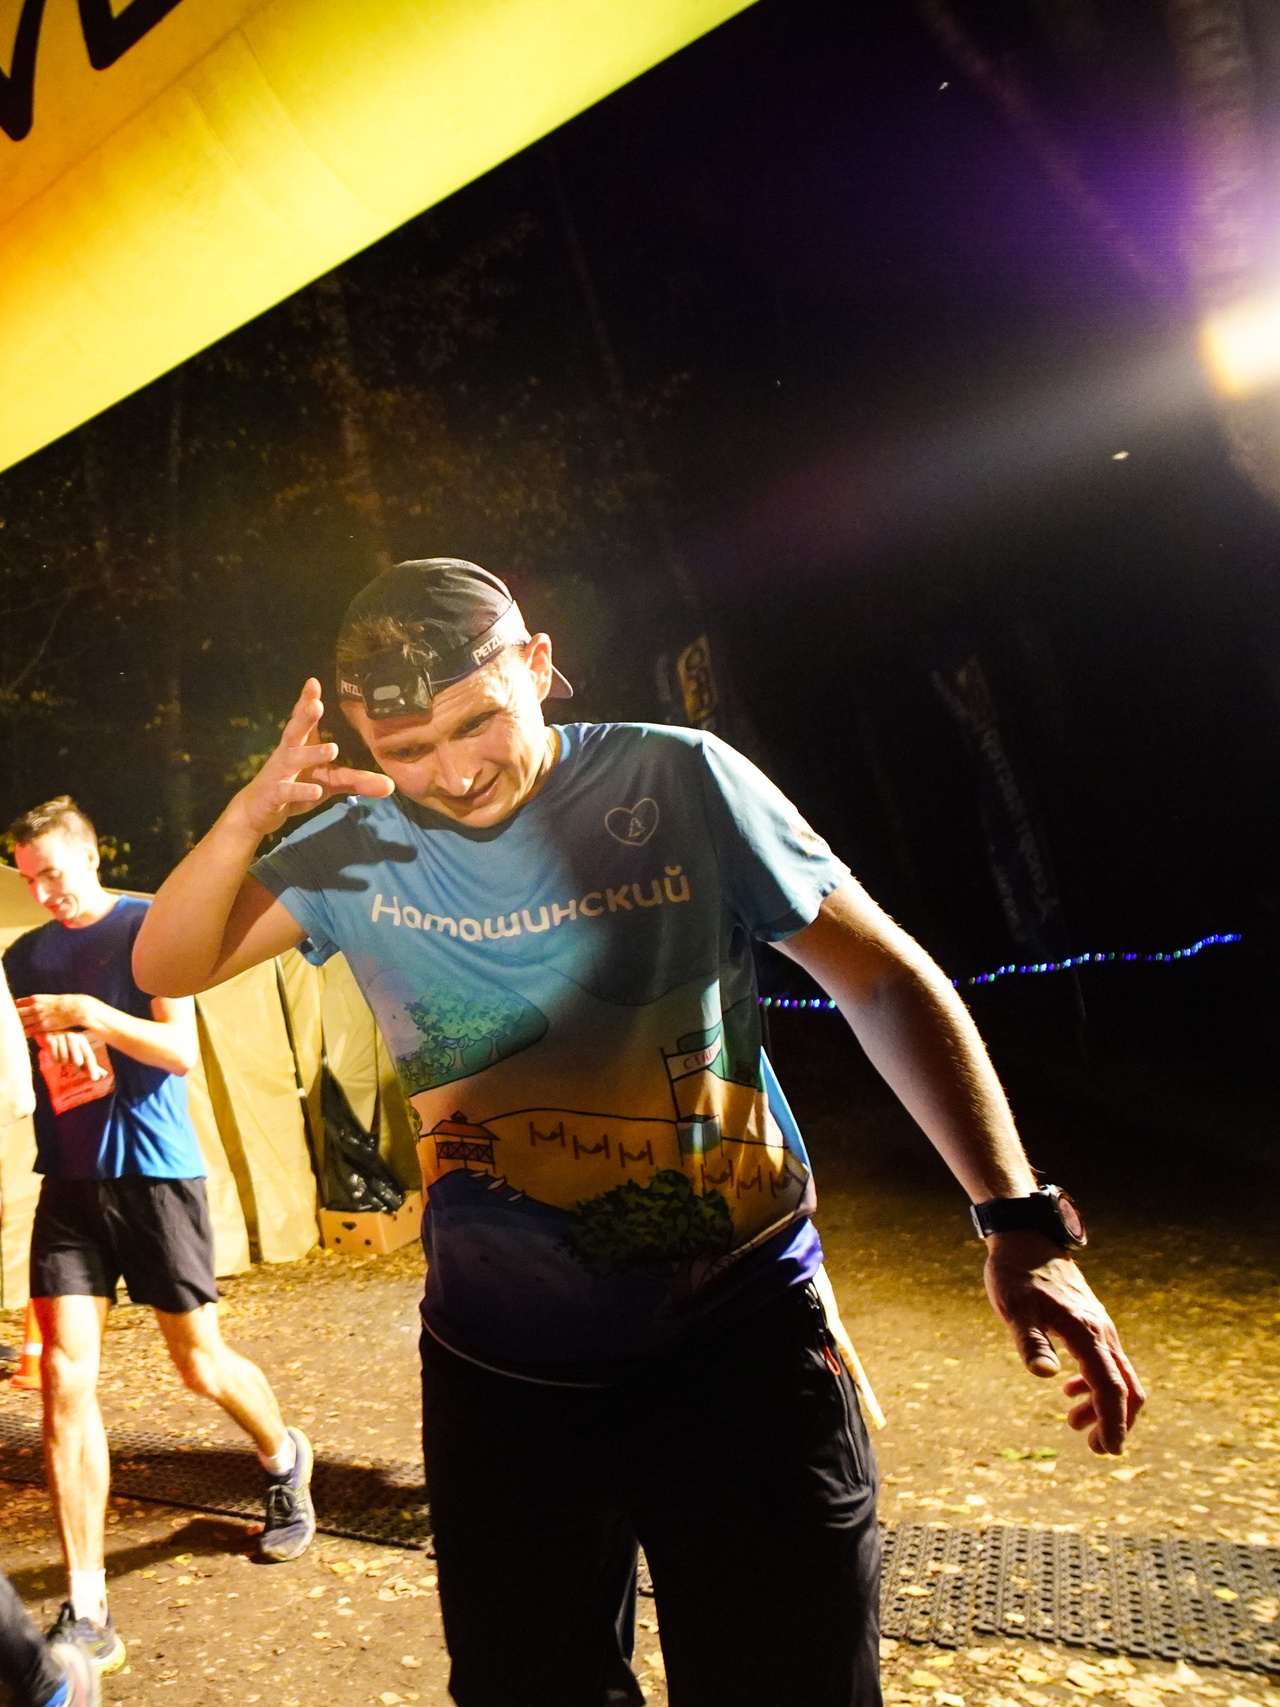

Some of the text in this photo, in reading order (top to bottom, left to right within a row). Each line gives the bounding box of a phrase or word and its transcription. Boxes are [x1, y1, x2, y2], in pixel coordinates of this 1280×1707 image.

[472, 634, 506, 666] PETZL
[341, 679, 363, 697] PETZL
[370, 865, 691, 942] Наташинский
